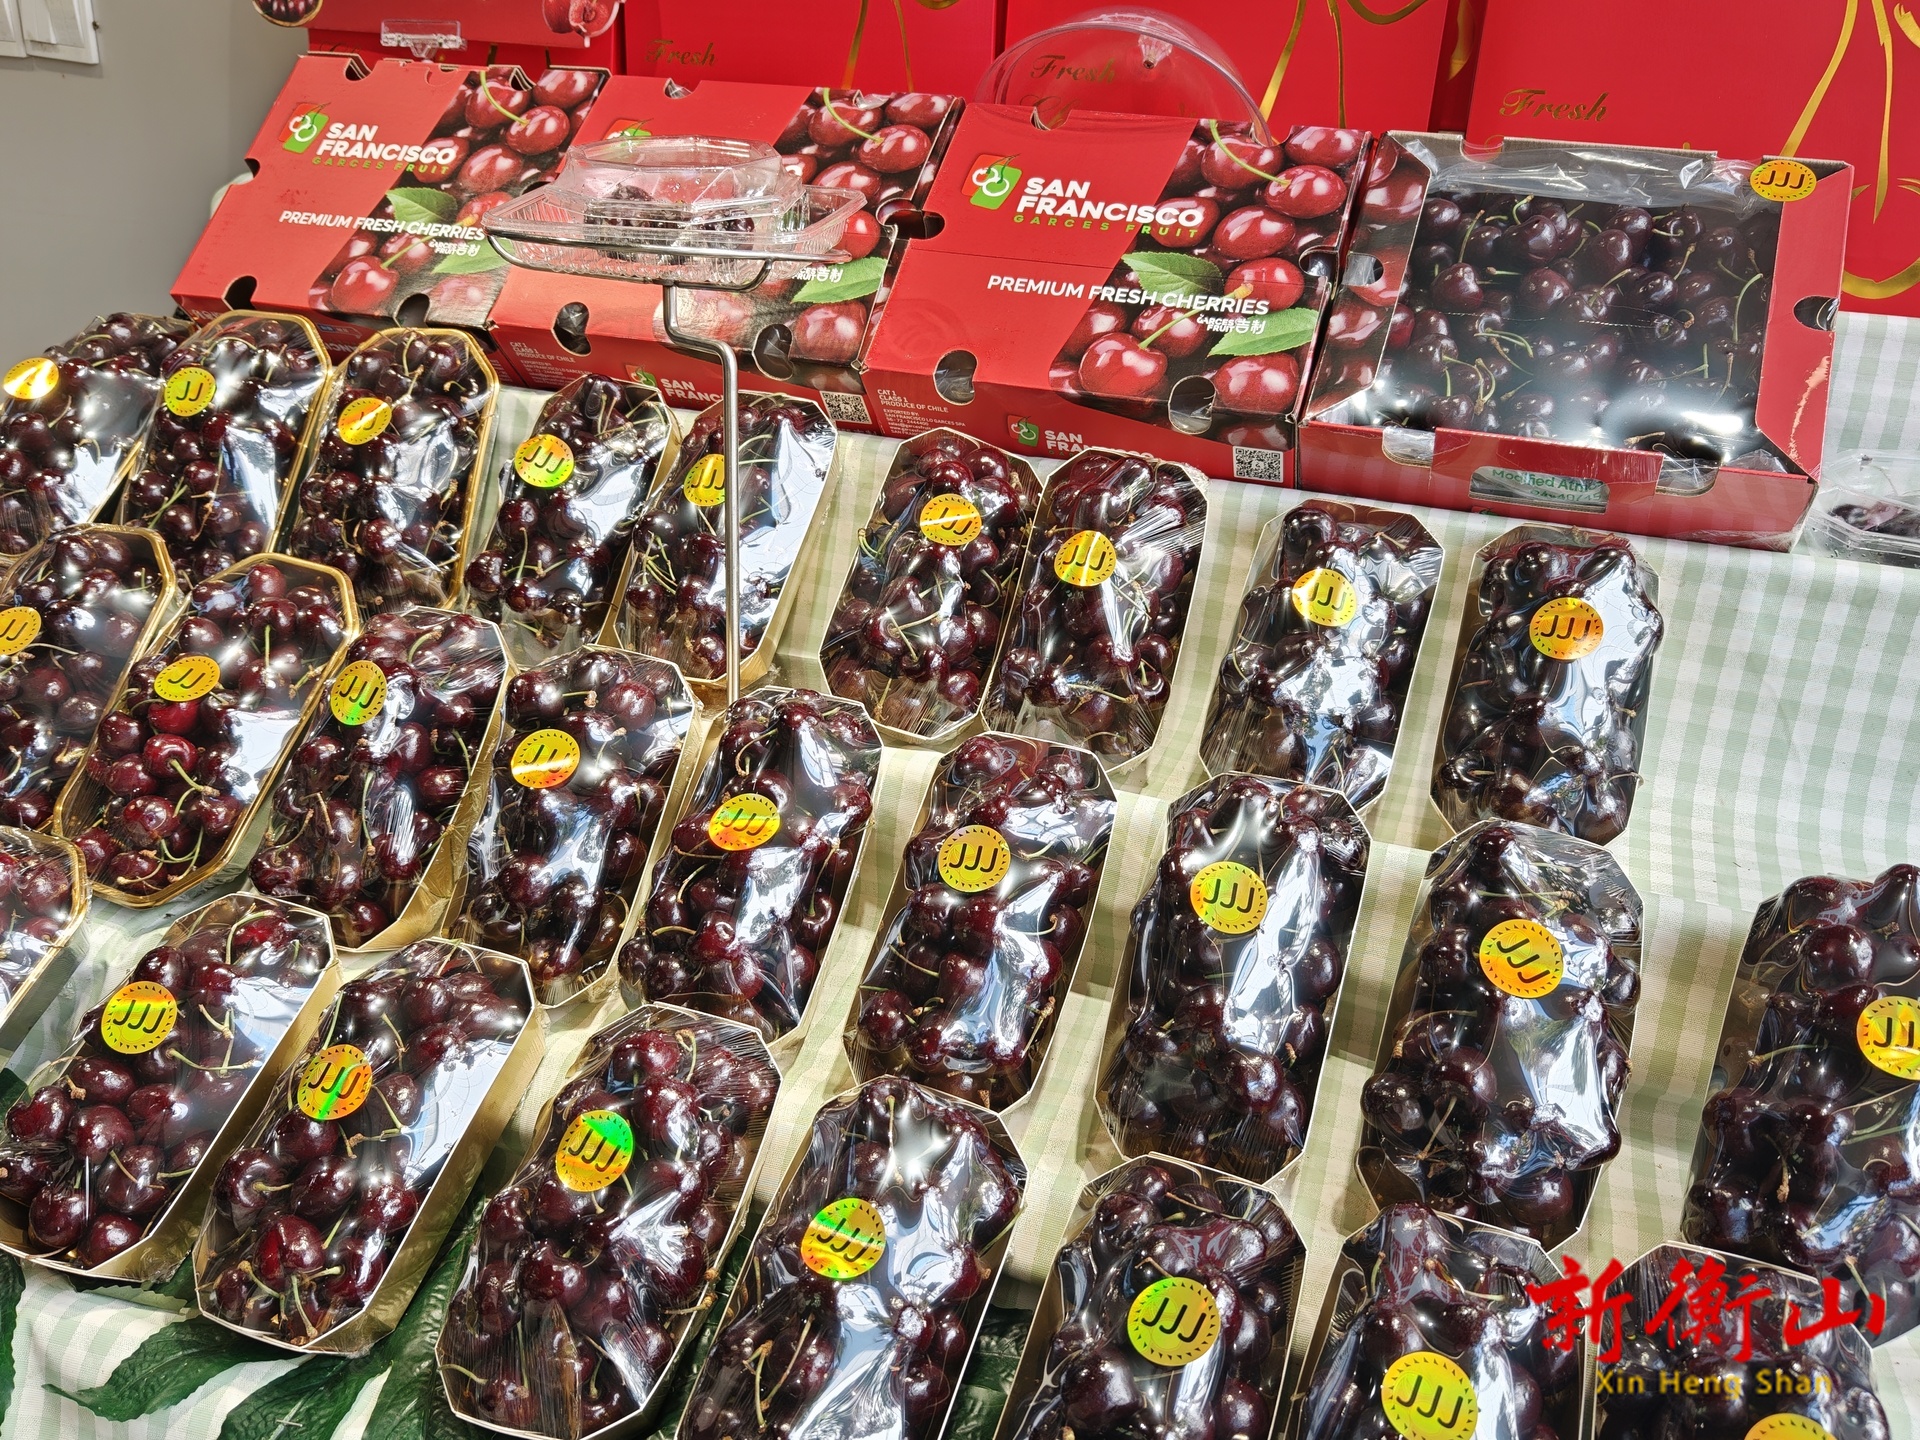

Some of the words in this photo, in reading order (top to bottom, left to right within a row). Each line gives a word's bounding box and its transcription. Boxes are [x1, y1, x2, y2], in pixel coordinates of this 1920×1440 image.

[645, 39, 715, 67] Fresh
[1030, 54, 1116, 84] Fresh
[1500, 88, 1609, 122] Fresh
[326, 122, 378, 142] SAN
[312, 157, 385, 170] GARCES
[394, 162, 449, 175] FRUIT
[316, 140, 456, 165] FRANCISCO
[1024, 177, 1091, 199] SAN
[1760, 170, 1806, 190] JJJ
[1016, 195, 1204, 227] FRANCISCO
[278, 210, 353, 229] PREMIUM
[352, 217, 407, 234] FRESH
[406, 221, 485, 241] CHERRIES
[1013, 214, 1110, 231] GARCES
[1125, 224, 1198, 238] FRUIT
[987, 275, 1085, 299] PREMIUM
[1088, 284, 1160, 306] FRESH
[1161, 291, 1270, 315] CHERRIES
[1196, 314, 1235, 326] GARCES
[1206, 323, 1235, 333] FRUIT
[516, 352, 546, 360] PRODUCE
[176, 381, 204, 401] JJ
[661, 378, 696, 391] SAN
[665, 388, 724, 403] FRANC
[881, 400, 915, 409] PRODUCE
[927, 405, 949, 413] CHILE
[1044, 429, 1083, 444] SAN
[523, 445, 565, 475] JJJ
[1062, 545, 1107, 572] JJJ
[1540, 614, 1591, 642] JJJ
[167, 667, 206, 690] JJ
[339, 675, 379, 709] JJJ
[523, 744, 571, 773] JJJ
[720, 808, 770, 836] JJJ
[949, 843, 998, 873] JJJ
[1202, 878, 1256, 914] JJJ
[1496, 938, 1550, 984] JJJ
[112, 999, 167, 1034] JJJ
[307, 1062, 361, 1099] JJJ
[568, 1128, 622, 1173] JJJ
[816, 1217, 874, 1262] JJJ
[1141, 1296, 1207, 1343] JJJ
[1396, 1374, 1463, 1429] JJJ
